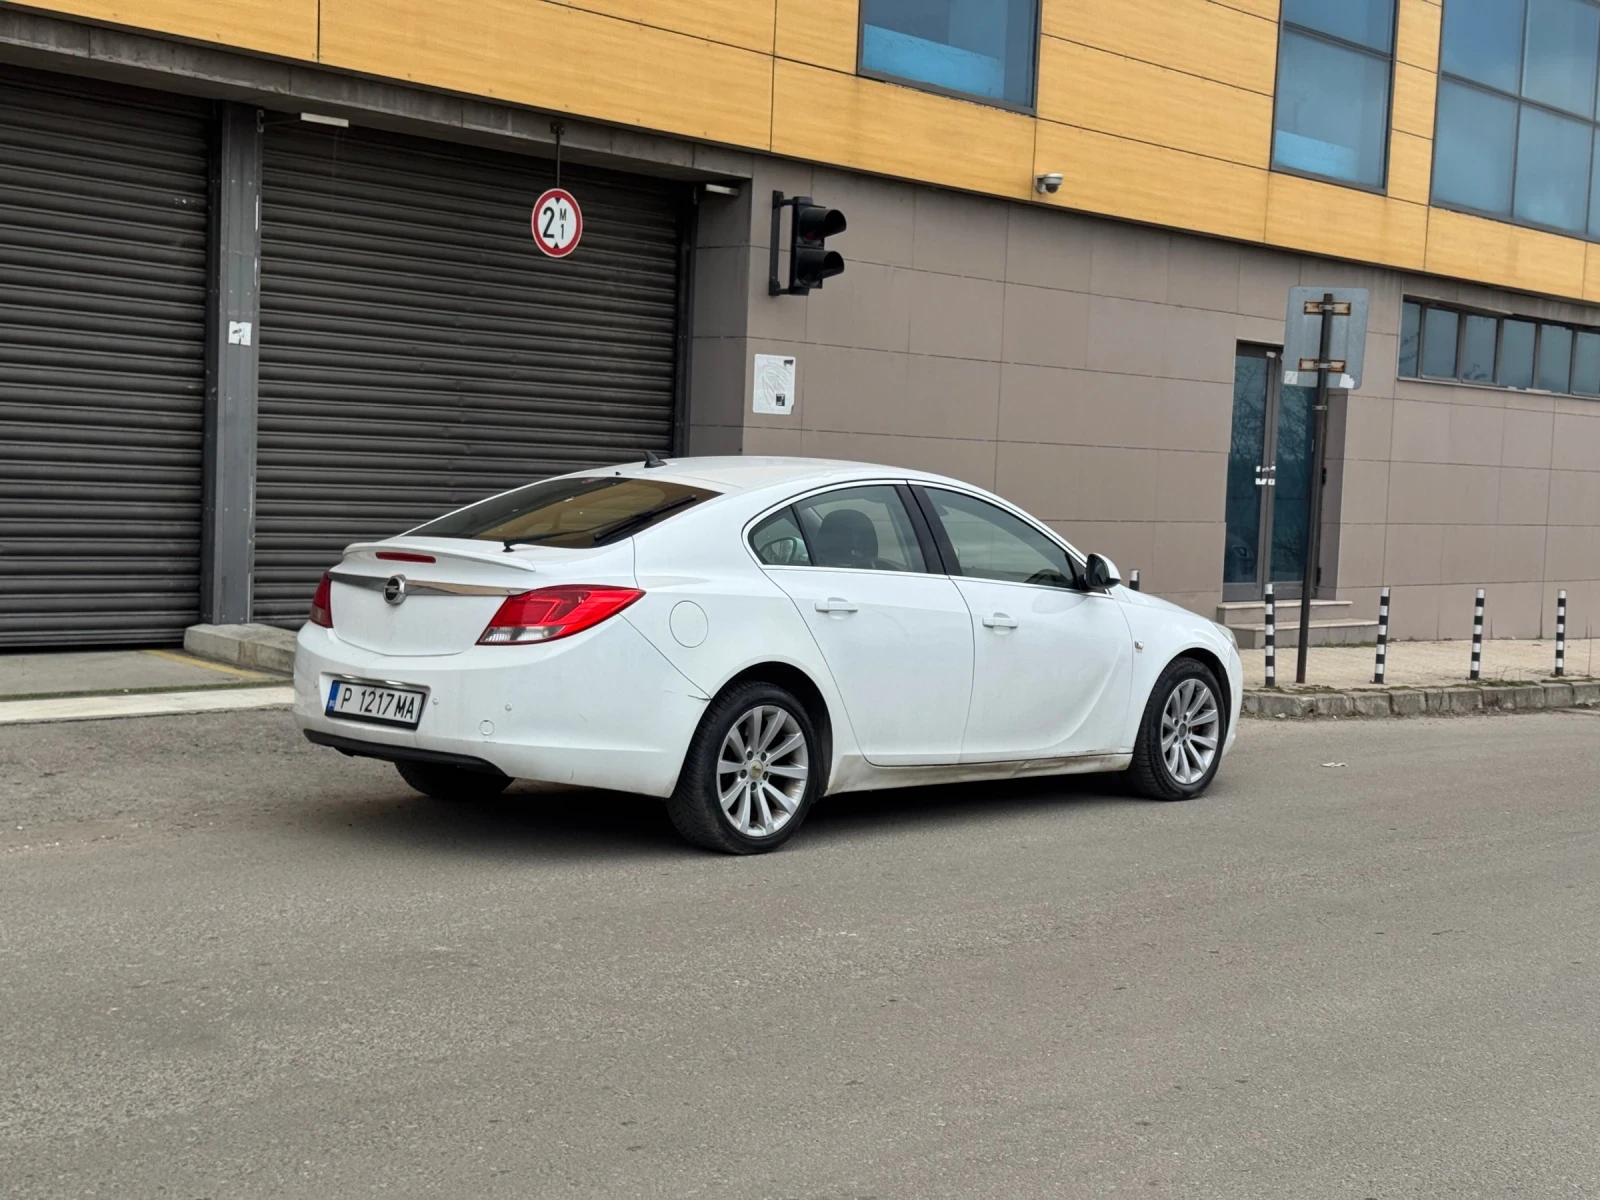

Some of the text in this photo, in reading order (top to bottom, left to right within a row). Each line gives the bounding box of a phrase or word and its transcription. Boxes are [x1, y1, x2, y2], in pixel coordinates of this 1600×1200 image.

[543, 206, 555, 239] 2
[559, 208, 567, 221] M
[560, 223, 565, 240] 1
[340, 687, 353, 709] P
